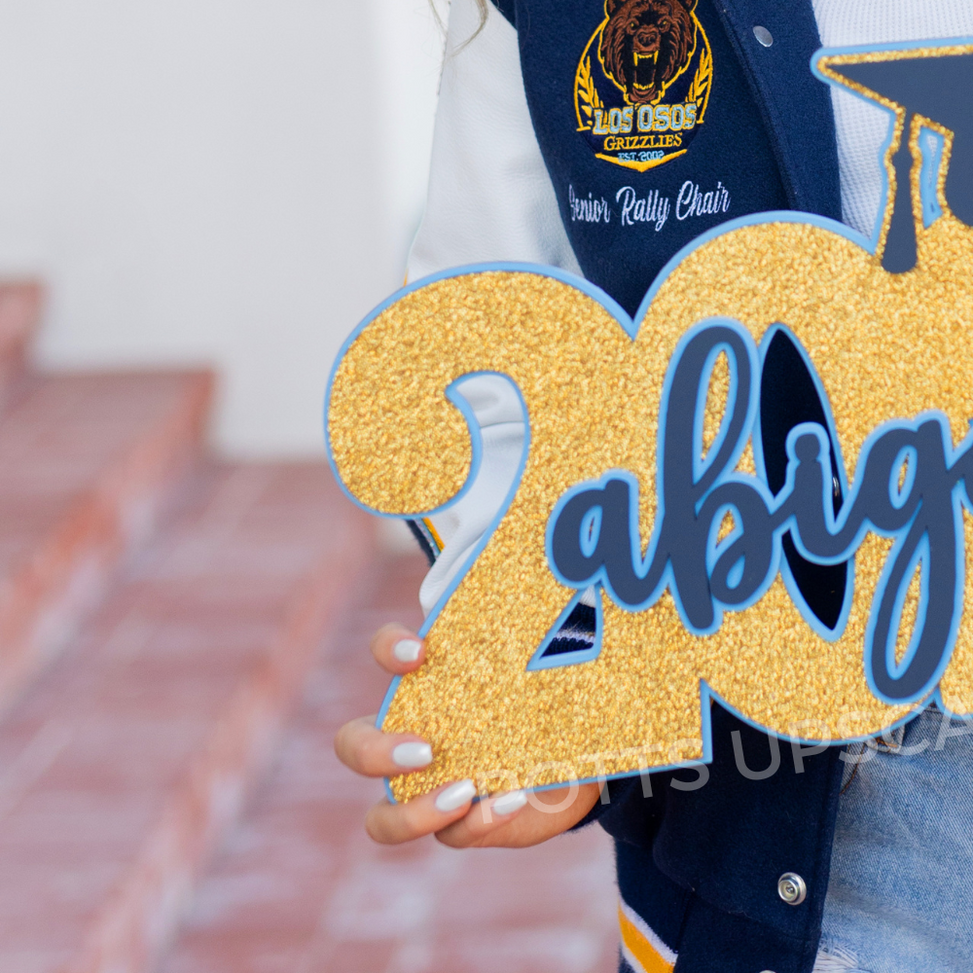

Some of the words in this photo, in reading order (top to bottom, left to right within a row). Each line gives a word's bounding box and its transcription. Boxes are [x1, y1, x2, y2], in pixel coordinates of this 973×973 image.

[593, 106, 634, 135] LOS
[637, 103, 697, 132] OSOS
[569, 184, 610, 223] Senior
[616, 186, 670, 232] Rally
[675, 180, 731, 221] Chair
